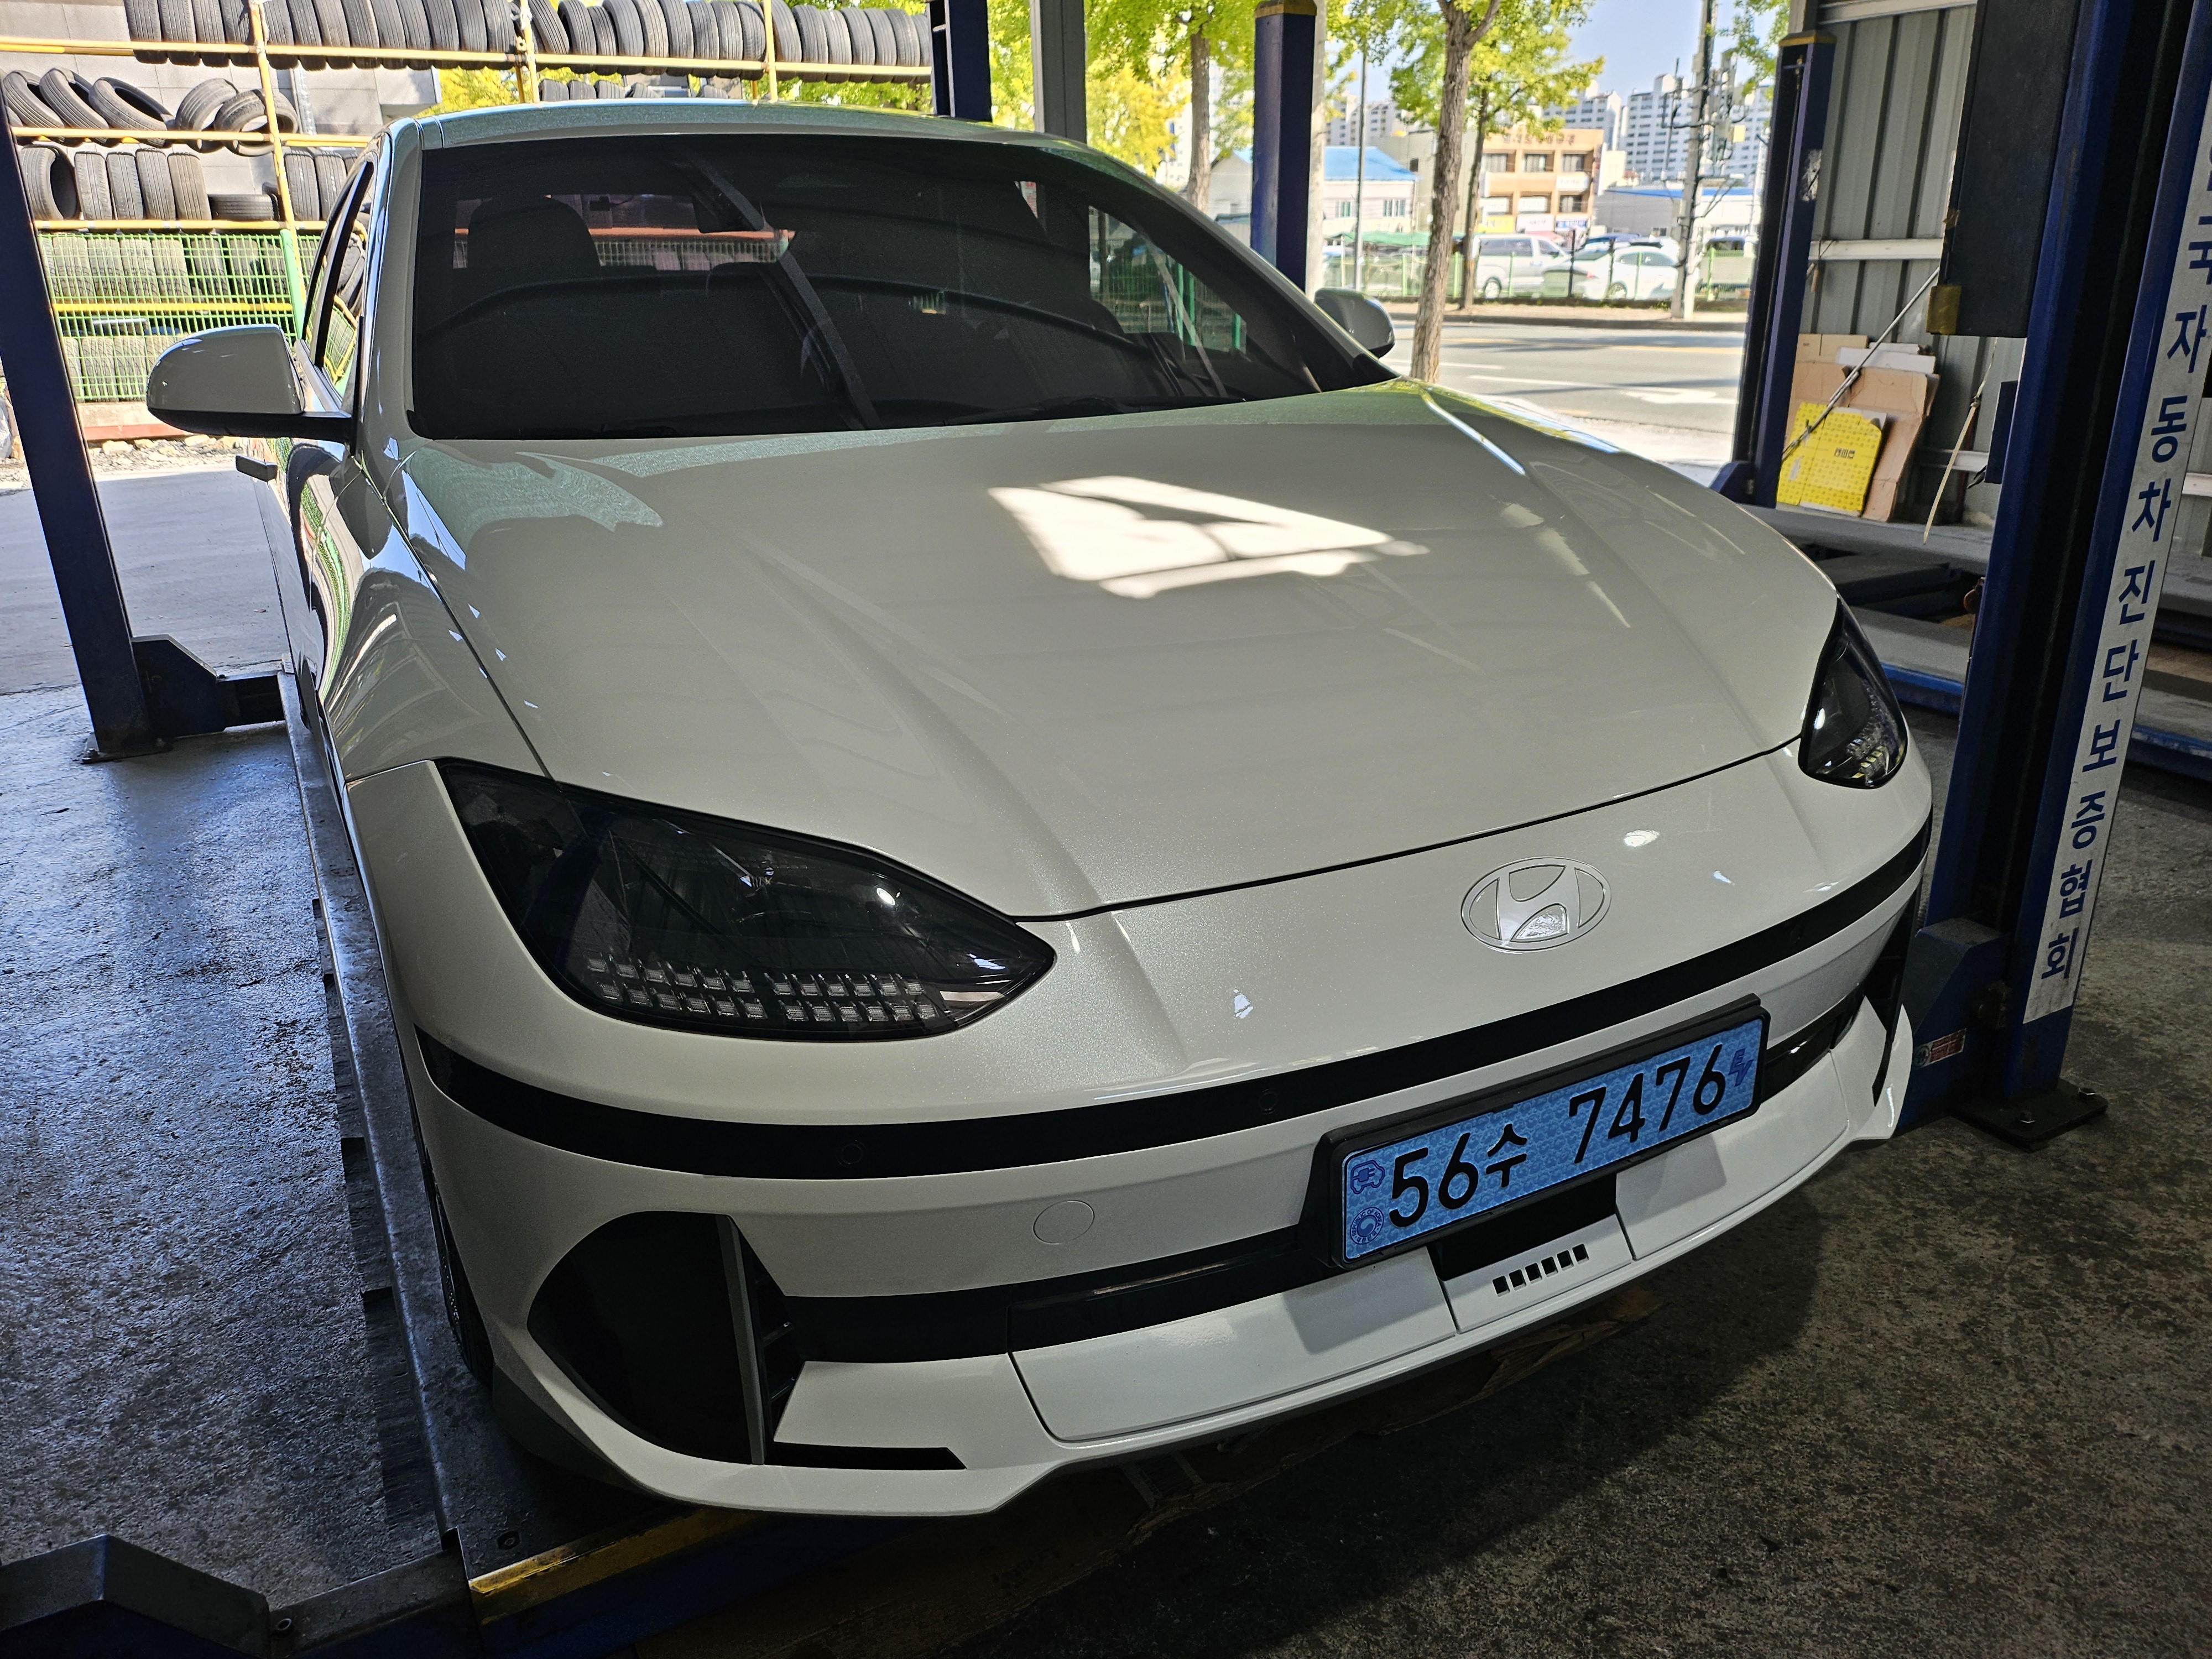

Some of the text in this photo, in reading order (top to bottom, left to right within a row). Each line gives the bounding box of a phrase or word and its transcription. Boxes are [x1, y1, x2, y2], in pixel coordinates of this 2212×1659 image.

[1728, 1048, 1754, 1087] EV
[1388, 1044, 1726, 1228] 56수 7476
[1352, 1211, 1366, 1237] REPUBLIC
[1374, 1211, 1383, 1227] KOREA
